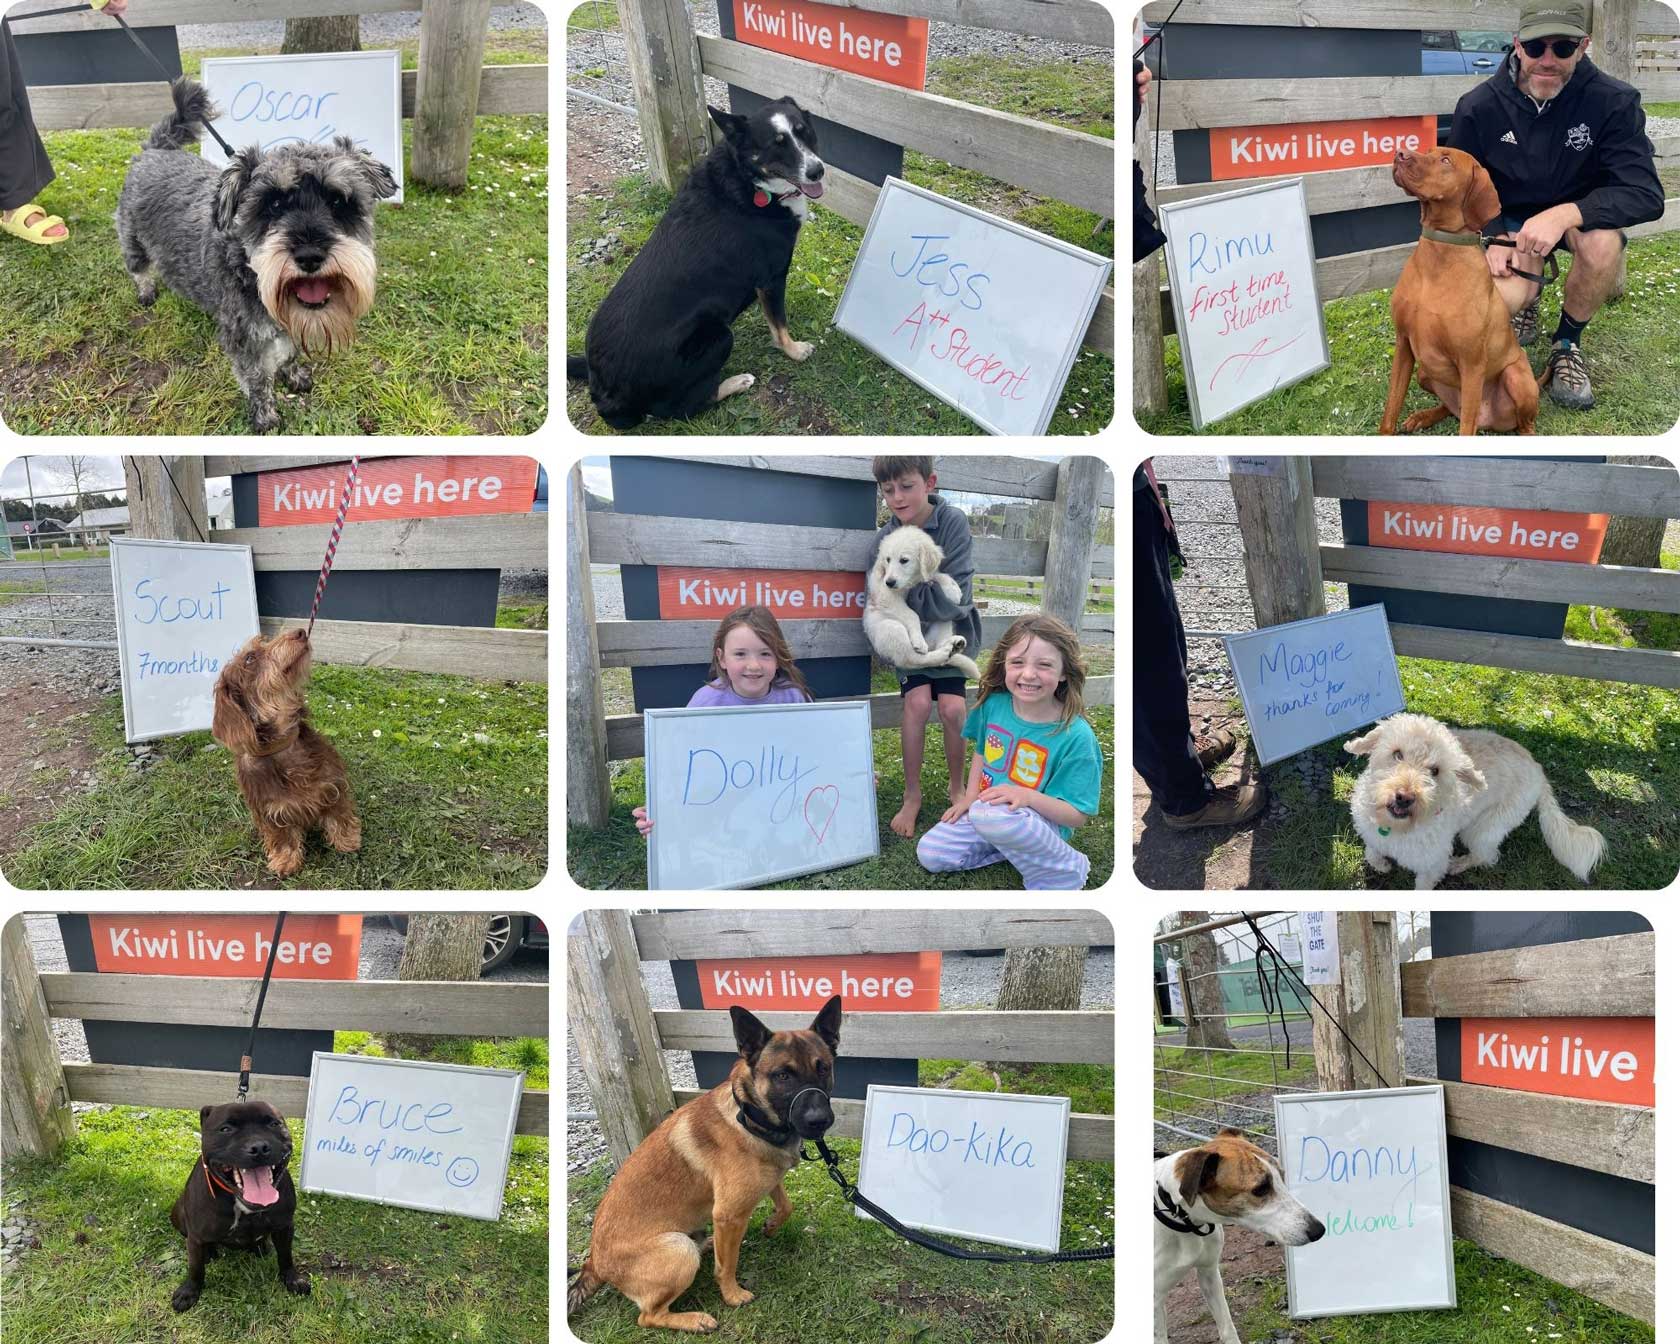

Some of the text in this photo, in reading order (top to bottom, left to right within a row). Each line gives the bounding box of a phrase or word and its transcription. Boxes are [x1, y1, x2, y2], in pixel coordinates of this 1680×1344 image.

[743, 1, 902, 67] Kiwi live here
[230, 81, 339, 122] Oscar
[1230, 130, 1420, 164] Kiwi live here
[890, 235, 990, 310] Jess
[1189, 231, 1274, 283] Rimu
[1246, 269, 1286, 297] time
[273, 473, 503, 512] Kiwi ive here
[1383, 510, 1580, 550] Kiwi live here
[134, 579, 231, 625] Scout
[679, 578, 747, 606] Kiwi
[755, 581, 804, 607] live
[1260, 640, 1352, 688] Maggie
[1264, 679, 1345, 721] thanks for
[682, 745, 819, 825] Dolly
[109, 927, 332, 965] Kiwi live here
[1309, 939, 1325, 951] GATE
[713, 969, 914, 998] Kiwi live here
[1478, 1032, 1638, 1082] Kiwi live
[328, 1086, 464, 1134] Bruce
[317, 1135, 443, 1167] miles of smiles
[1299, 1136, 1432, 1210] Danny
[1324, 1202, 1414, 1237] elcome!
